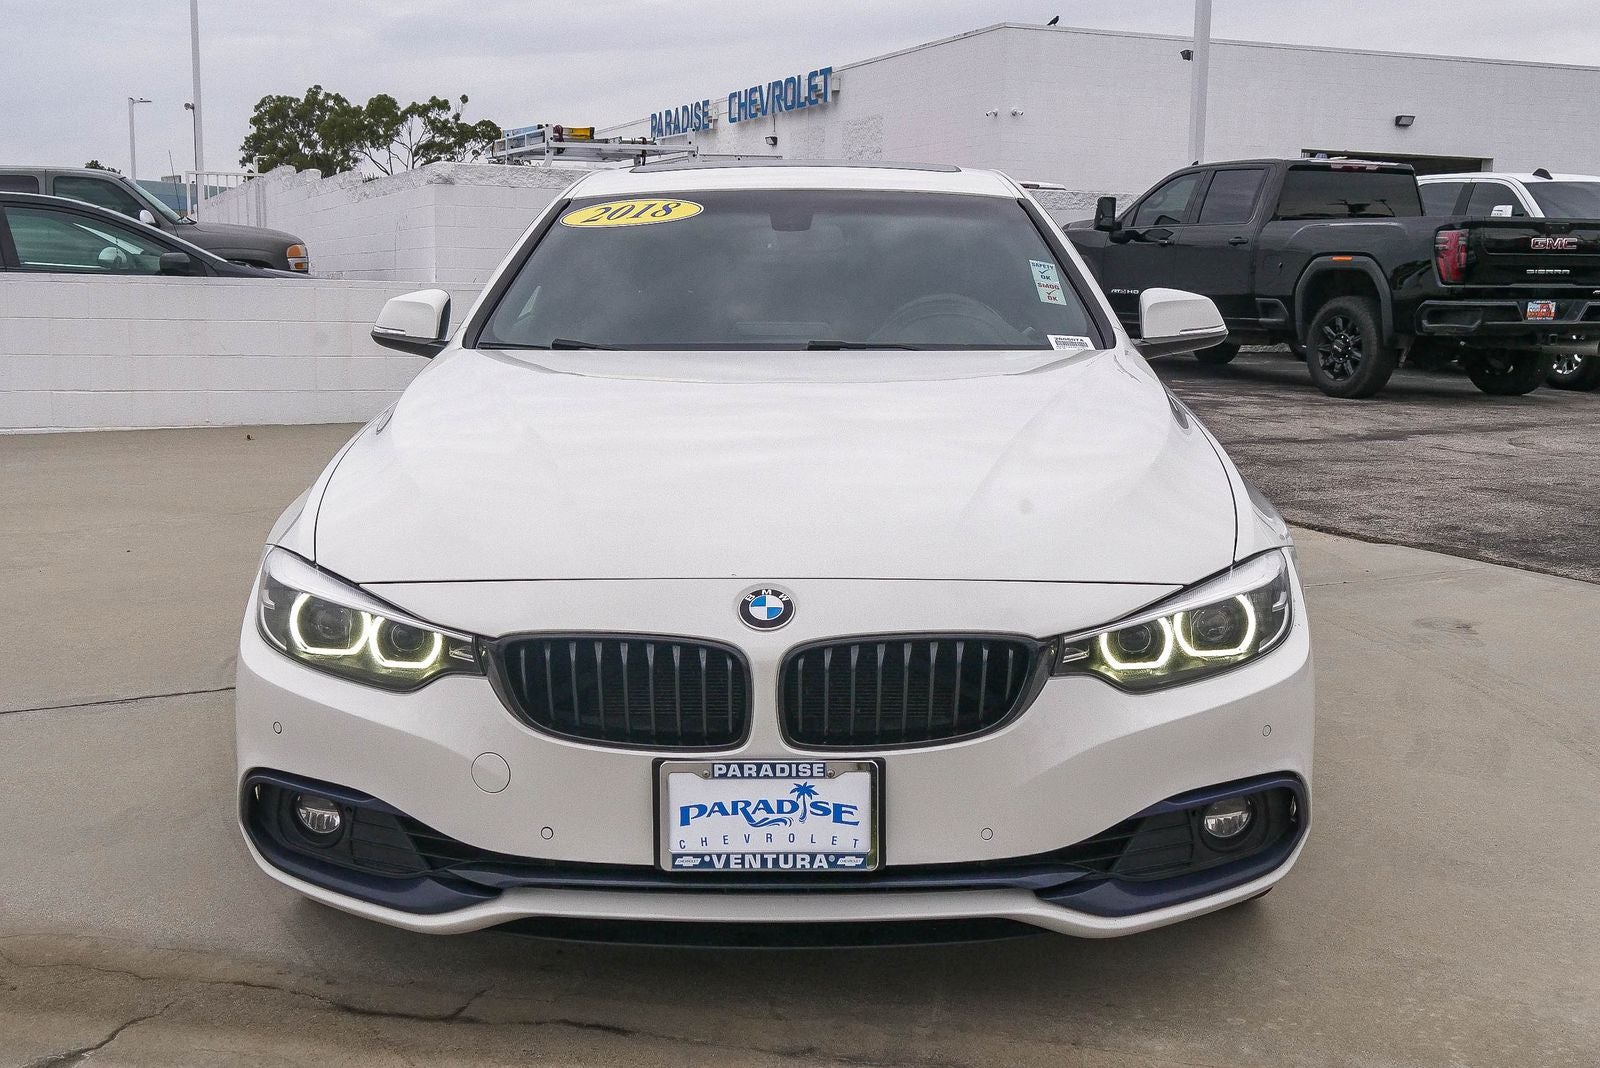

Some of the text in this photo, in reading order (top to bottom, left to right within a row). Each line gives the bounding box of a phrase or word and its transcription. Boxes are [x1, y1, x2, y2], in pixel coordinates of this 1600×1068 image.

[651, 66, 832, 138] PARADISE CHEVROLET
[580, 203, 681, 223] 2018
[1531, 238, 1577, 249] GMC
[1031, 262, 1054, 270] SAFETY
[1037, 282, 1060, 290] SMOG
[744, 589, 790, 601] BMW
[713, 763, 825, 777] PARADISE
[680, 782, 860, 827] PARADISE
[679, 833, 859, 849] CHEVROLET
[711, 854, 828, 869] VENTURA
